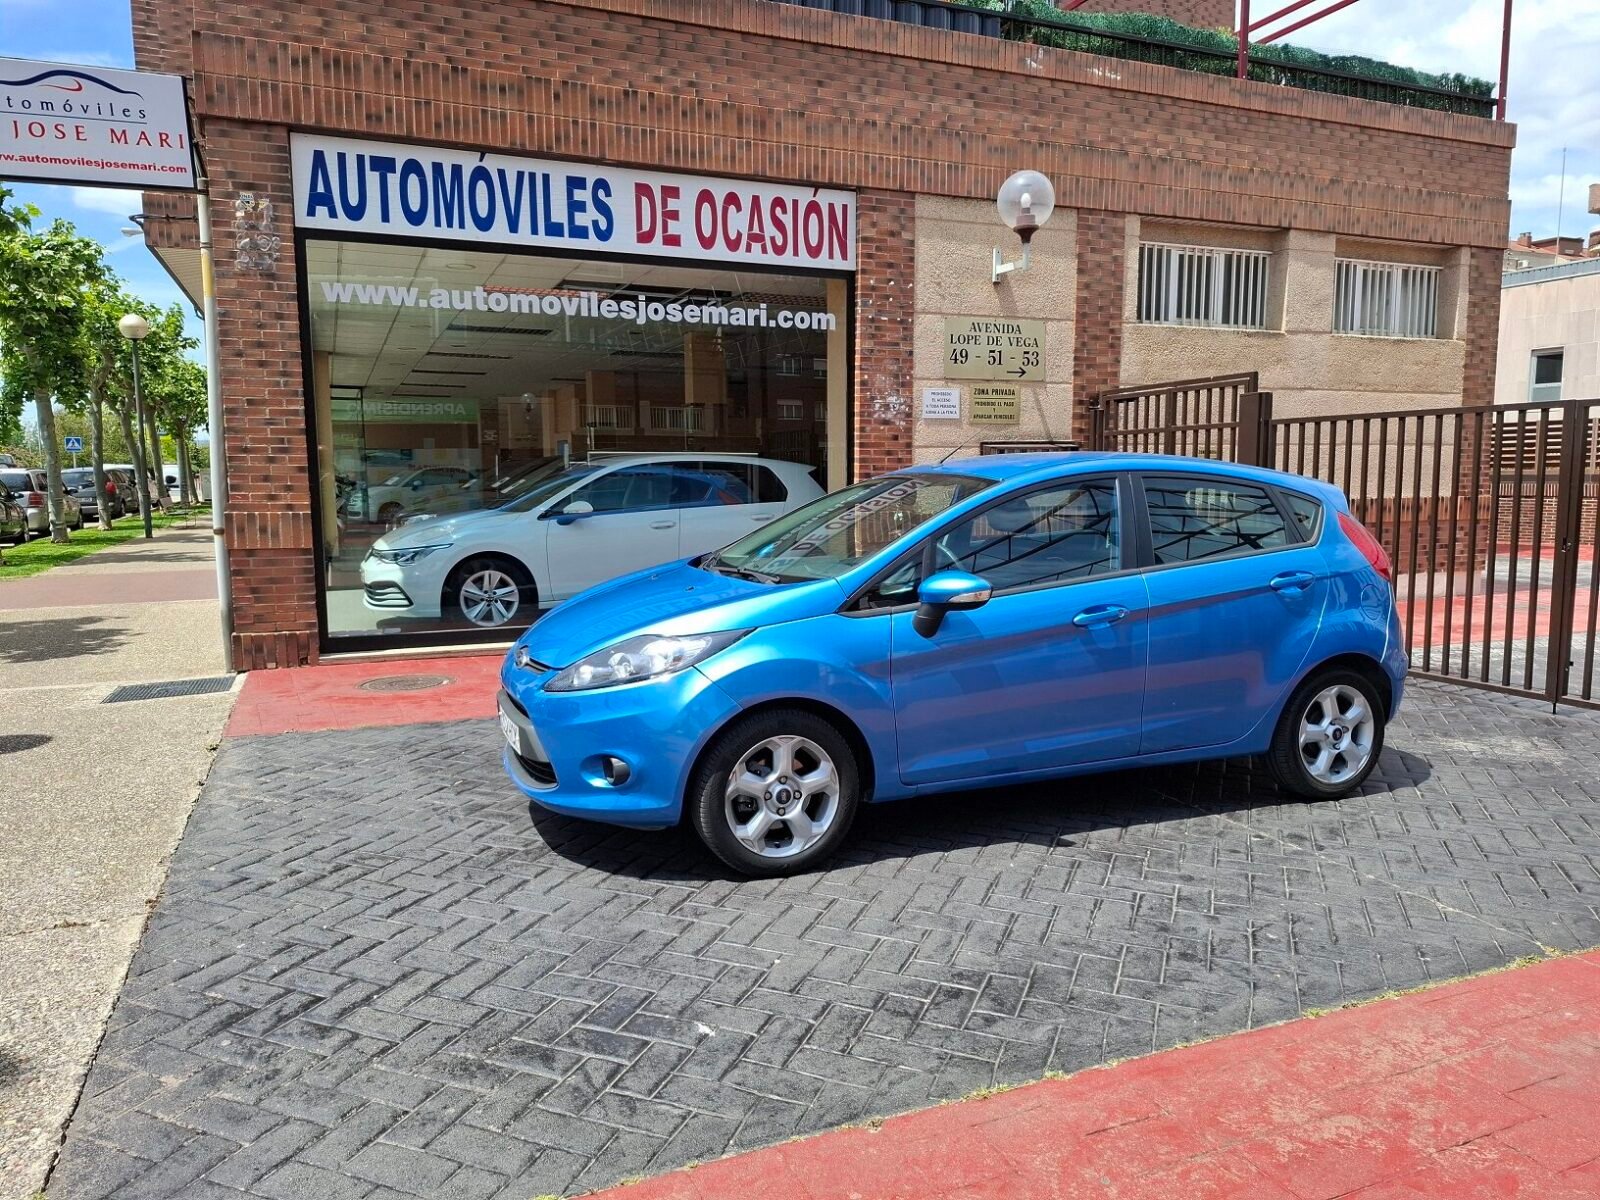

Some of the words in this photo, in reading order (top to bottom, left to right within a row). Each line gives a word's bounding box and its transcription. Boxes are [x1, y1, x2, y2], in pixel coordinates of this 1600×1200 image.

[13, 120, 87, 142] JOSE
[110, 127, 185, 149] MARI
[306, 149, 614, 242] AUTOMÓVILES
[634, 182, 682, 247] DE
[694, 187, 848, 261] OCASIÓN
[321, 281, 836, 331] www.automovilesjosemari.com
[969, 322, 1022, 335] AVENIDA
[950, 334, 981, 345] LOPE
[986, 335, 1003, 346] DE
[1008, 337, 1039, 348] VEGA
[949, 348, 969, 365] 49
[987, 349, 1004, 366] 51
[1022, 350, 1040, 367] 53
[973, 387, 989, 396] ZONA
[991, 388, 1016, 396] PRIVADA
